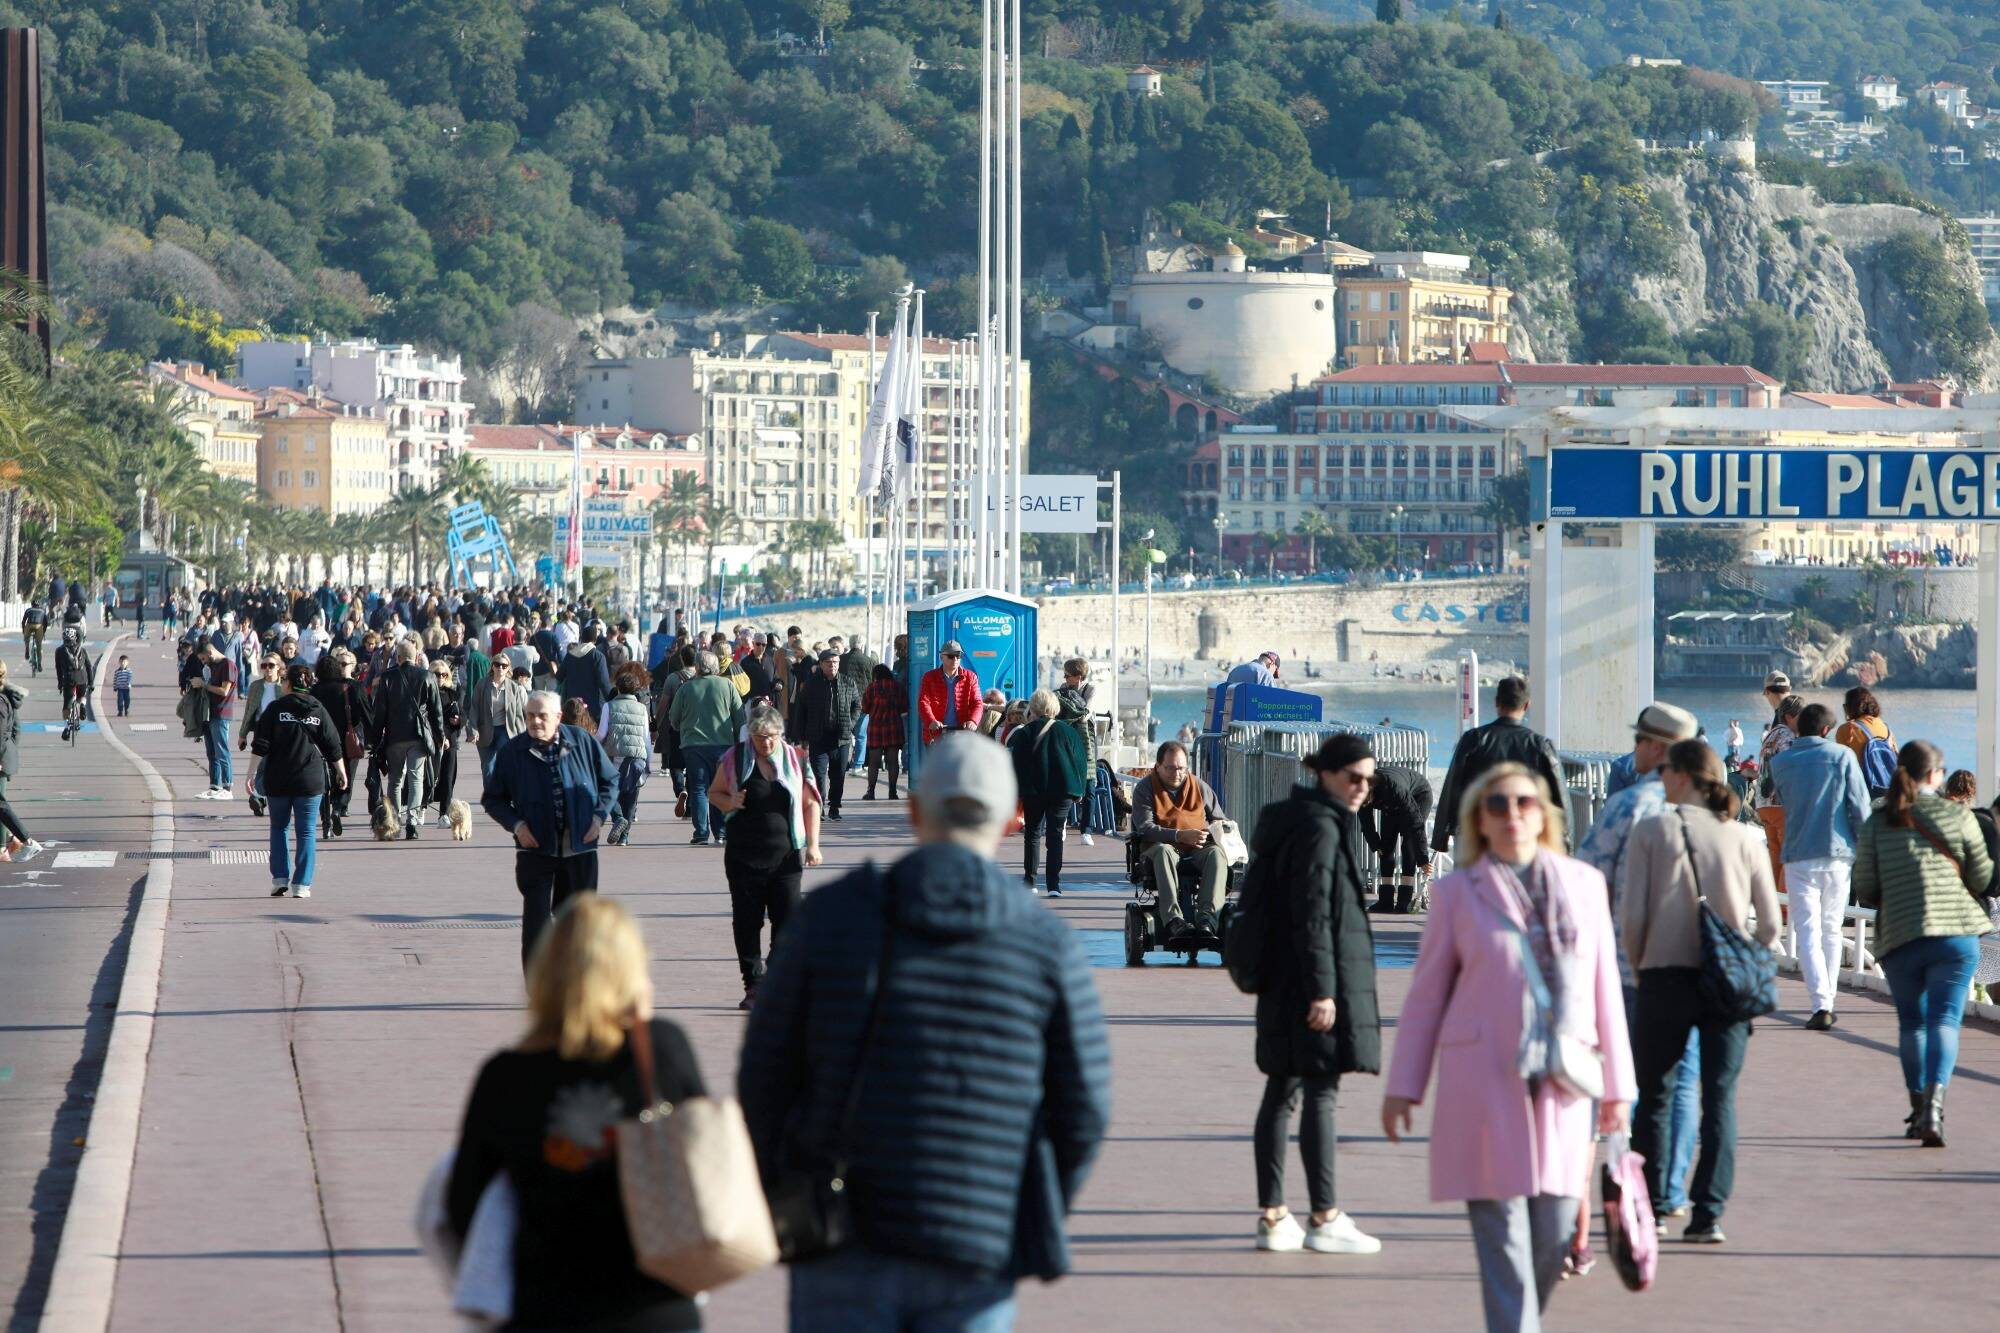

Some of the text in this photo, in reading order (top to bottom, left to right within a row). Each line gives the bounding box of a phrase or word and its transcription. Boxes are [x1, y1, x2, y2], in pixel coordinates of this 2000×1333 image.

[1640, 452, 1800, 516] RUHL
[1019, 495, 1085, 512] GALET
[599, 516, 649, 531] RIVAGE
[963, 616, 1011, 625] ALLOMAT
